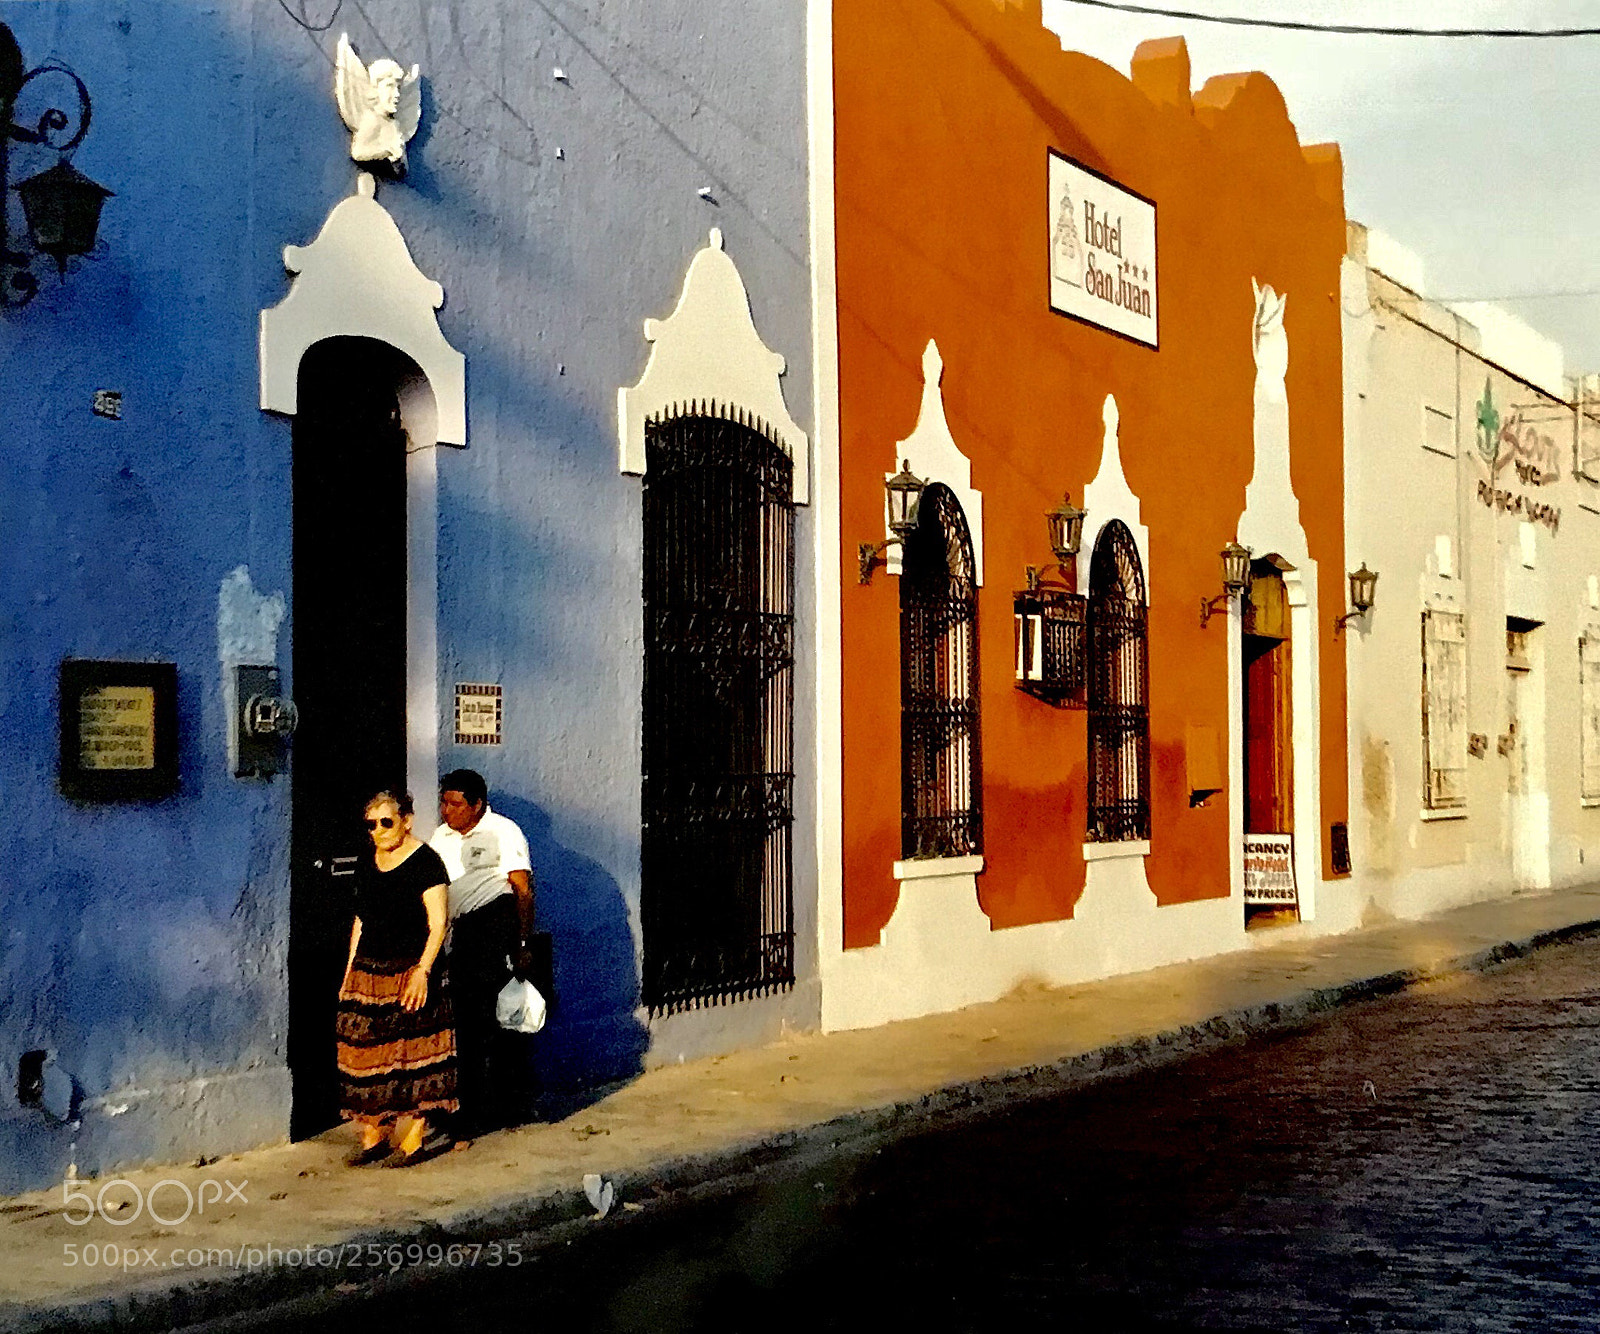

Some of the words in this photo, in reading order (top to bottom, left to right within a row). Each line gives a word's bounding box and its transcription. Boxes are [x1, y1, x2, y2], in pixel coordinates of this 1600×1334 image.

[1083, 199, 1123, 259] Hotel
[1084, 251, 1114, 304] San
[1114, 263, 1152, 319] Juan
[1257, 888, 1295, 899] PRICES
